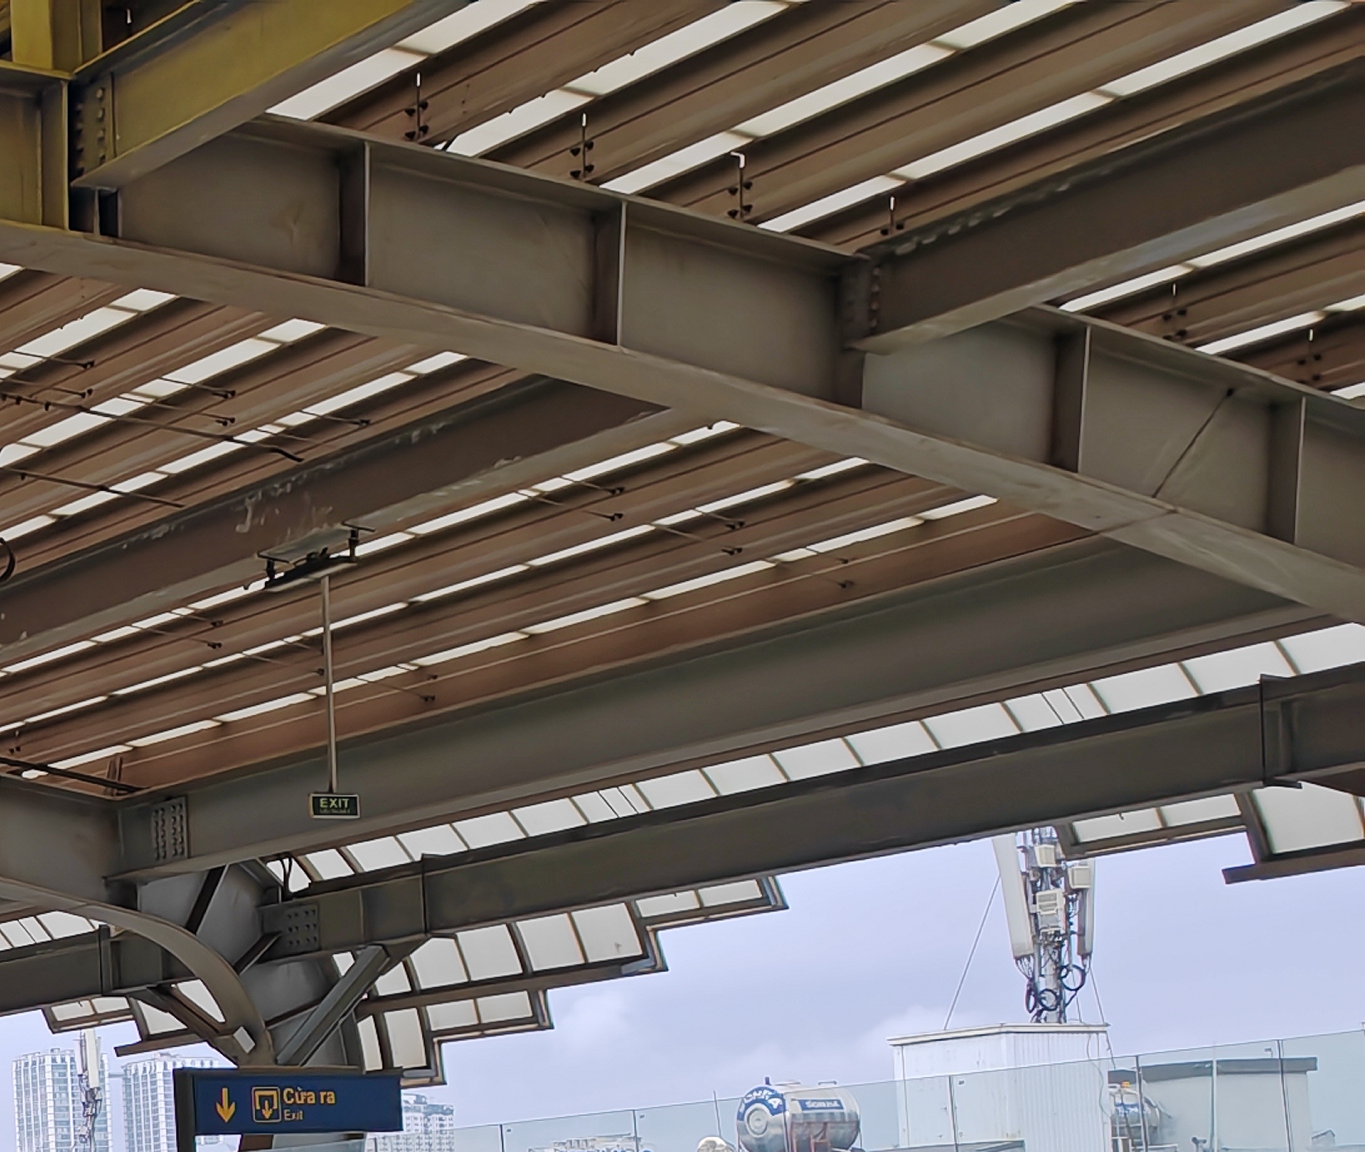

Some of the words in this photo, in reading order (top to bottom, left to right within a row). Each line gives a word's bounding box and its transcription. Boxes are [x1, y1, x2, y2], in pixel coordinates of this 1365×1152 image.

[319, 798, 349, 809] EXIT
[319, 1090, 336, 1104] ra
[283, 1109, 304, 1121] Exit
